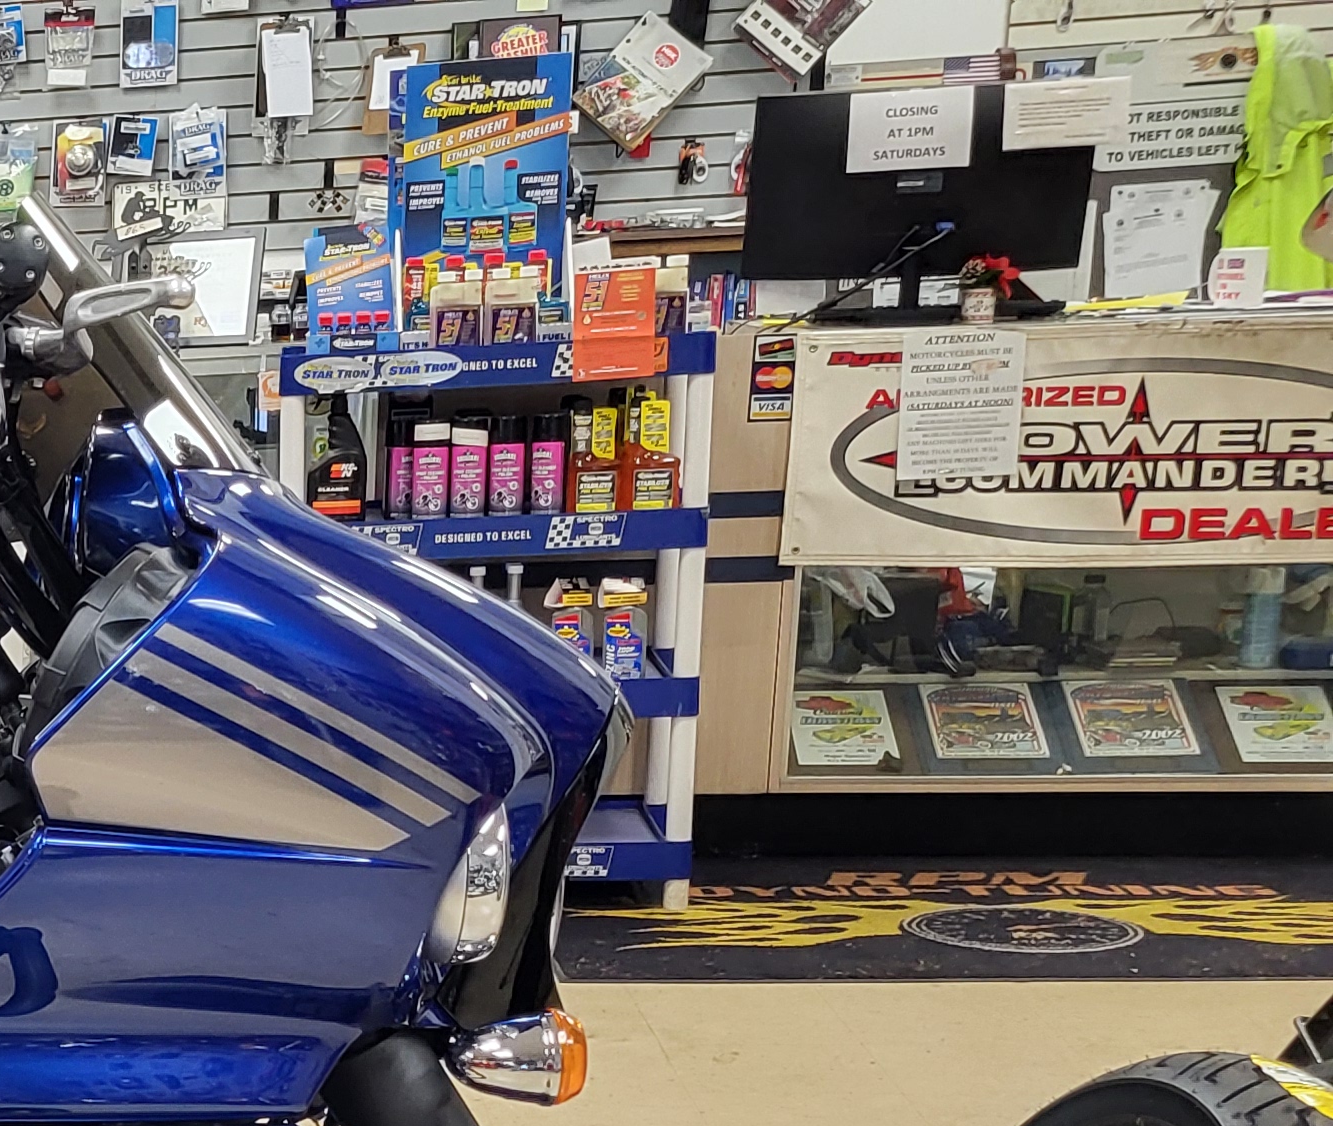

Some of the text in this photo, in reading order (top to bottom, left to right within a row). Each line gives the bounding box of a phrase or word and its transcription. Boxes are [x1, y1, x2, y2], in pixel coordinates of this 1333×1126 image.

[131, 70, 167, 81] DRAG
[432, 78, 547, 103] STAR TRON
[423, 96, 553, 119] Enzyme Fuel Treatment
[885, 105, 939, 119] CLOSING
[1146, 105, 1240, 123] RESPONSIBLE
[413, 117, 509, 156] CURE & PREVENT
[887, 126, 935, 140] AT 1PM
[1129, 128, 1172, 144] THEFT
[1175, 127, 1194, 140] OR
[446, 118, 564, 163] ETHANOL FUEL PROBLEMS
[872, 146, 946, 161] SATURDAYS
[1107, 143, 1226, 164] TO VEHICLES LEFT
[179, 181, 217, 194] DRAG
[542, 332, 565, 341] FUEL
[925, 333, 996, 346] ATTENTION
[909, 350, 975, 360] MOTORCYCLES
[389, 361, 458, 376] STAR TRON
[492, 359, 504, 370] TO
[506, 357, 538, 369] EXCEL
[911, 364, 945, 374] PICKED
[302, 368, 370, 380] STAR TRON
[758, 402, 785, 412] VISA
[1021, 419, 1333, 456] OWER
[576, 515, 618, 523] SPECTRO
[434, 529, 532, 544] DESIGNED TO EXCEL
[993, 732, 1035, 743] 2002
[1142, 729, 1183, 739] 2002
[824, 870, 1089, 886] RPM
[689, 884, 1285, 898] DYNO-TUNING
